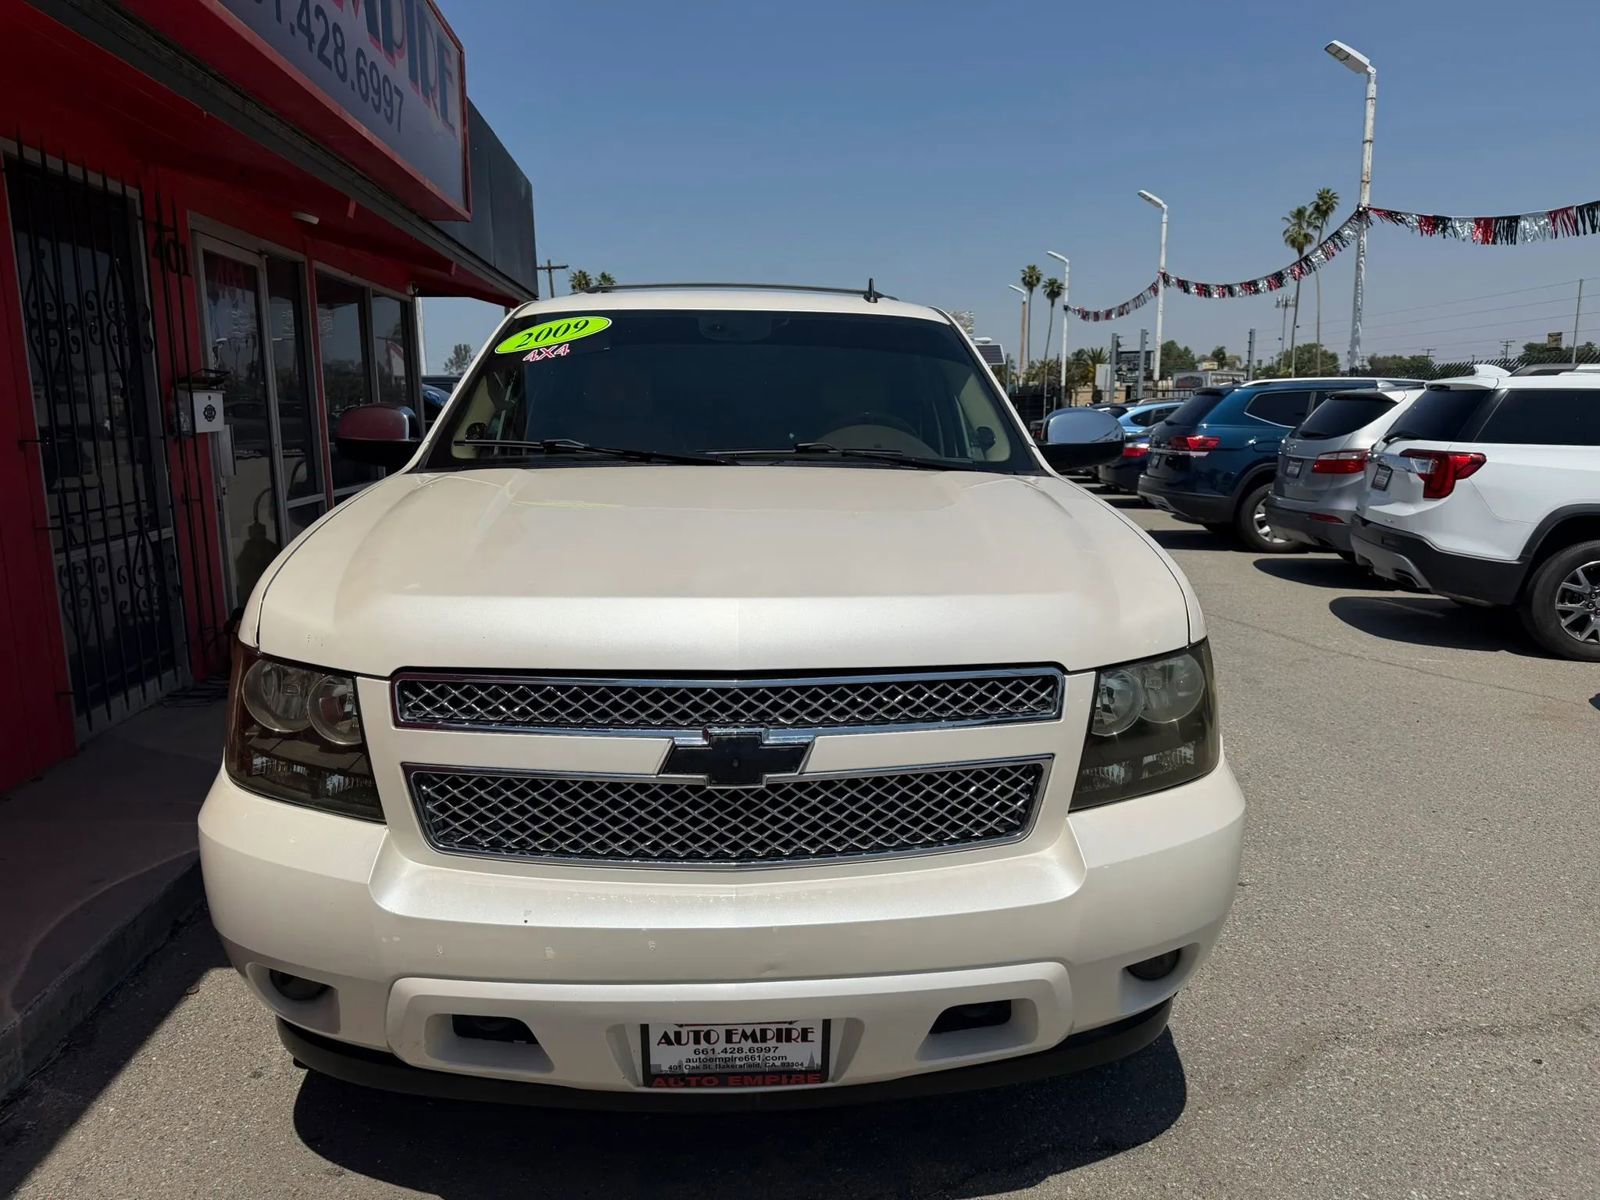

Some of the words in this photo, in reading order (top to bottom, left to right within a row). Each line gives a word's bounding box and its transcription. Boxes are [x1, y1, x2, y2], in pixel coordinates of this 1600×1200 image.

[515, 319, 589, 349] 2009
[656, 1028, 720, 1047] AUTO
[725, 1026, 815, 1044] EMPIRE
[693, 1046, 779, 1056] 661.428.6997
[685, 1054, 788, 1065] autoempire661.com
[684, 1063, 701, 1071] Oak
[652, 1075, 720, 1088] AUTO
[727, 1073, 822, 1086] EMPIRE
